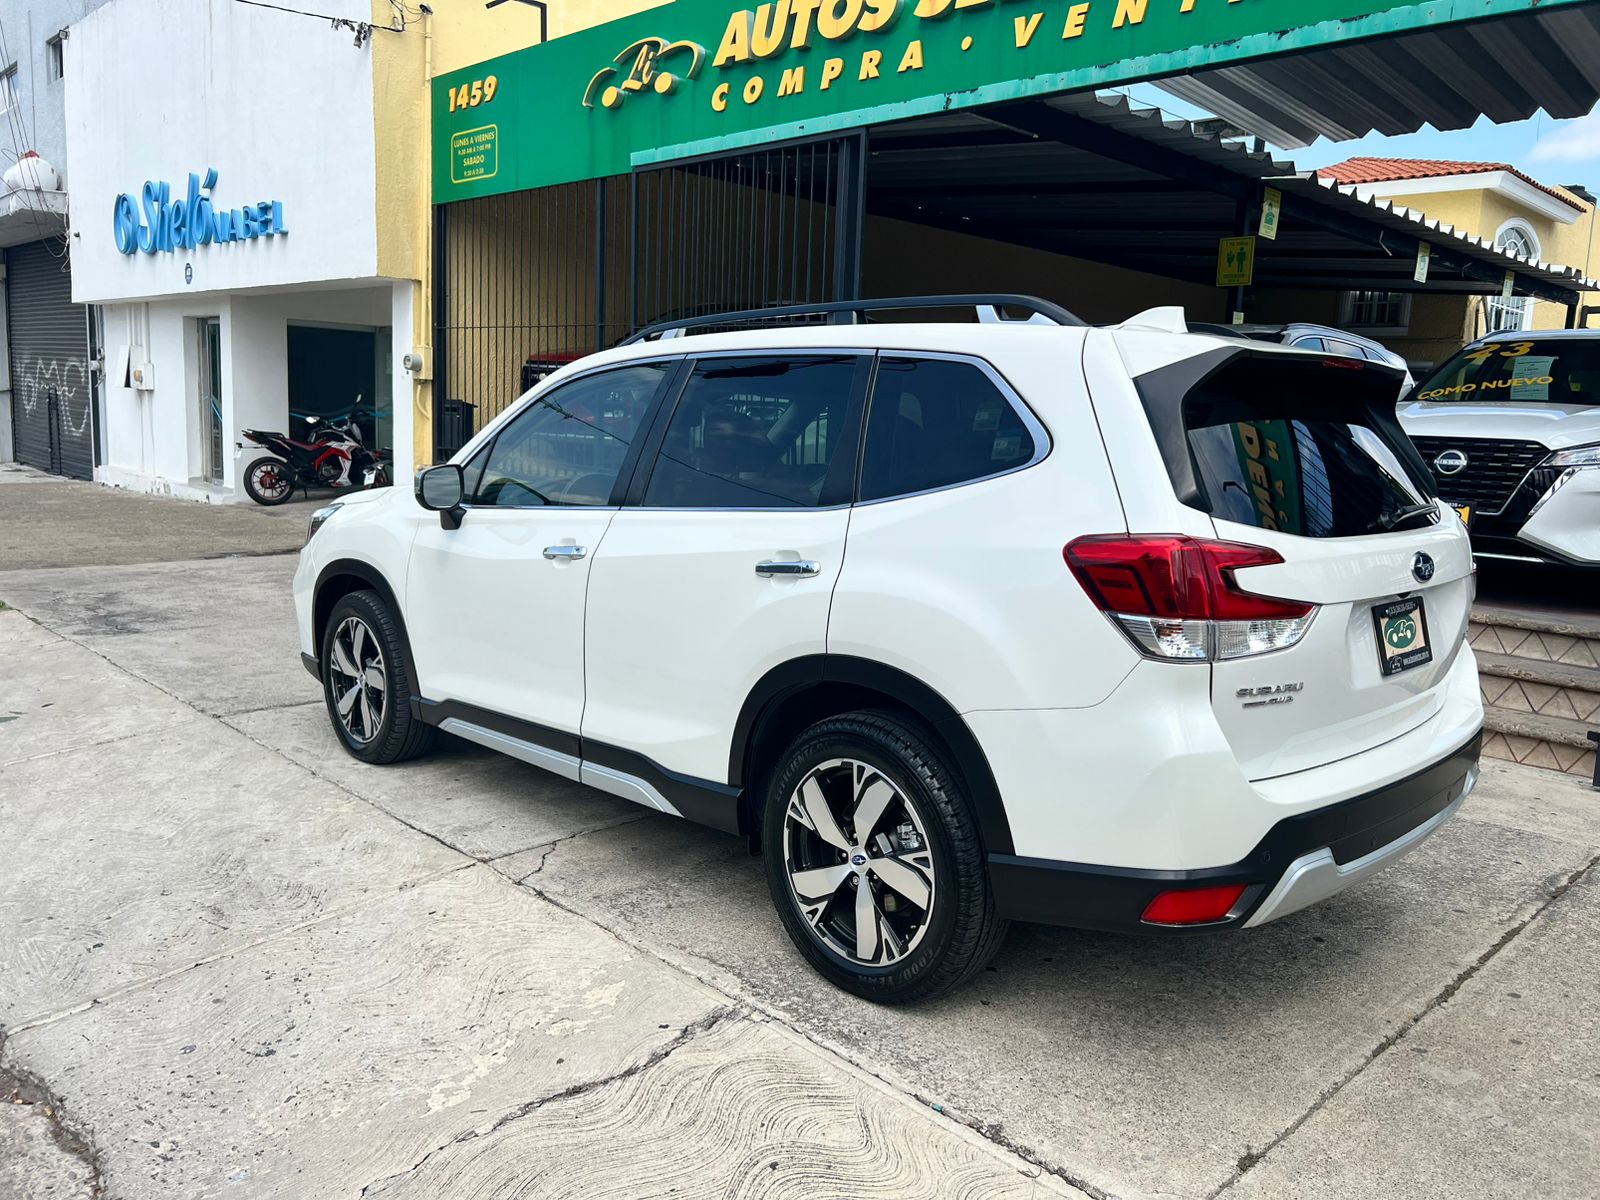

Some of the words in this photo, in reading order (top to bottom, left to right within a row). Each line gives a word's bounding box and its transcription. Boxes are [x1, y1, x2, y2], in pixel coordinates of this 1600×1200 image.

[712, 0, 899, 67] AUTOS
[711, 39, 924, 112] COMPRA
[449, 75, 498, 113] 1459
[453, 137, 469, 148] LUNES
[474, 132, 494, 143] VIERNES
[464, 155, 484, 166] SABADO
[212, 200, 289, 244] NABEL
[1417, 383, 1477, 400] COMO
[1481, 376, 1554, 390] NUEVO
[1236, 682, 1304, 698] SUBARU
